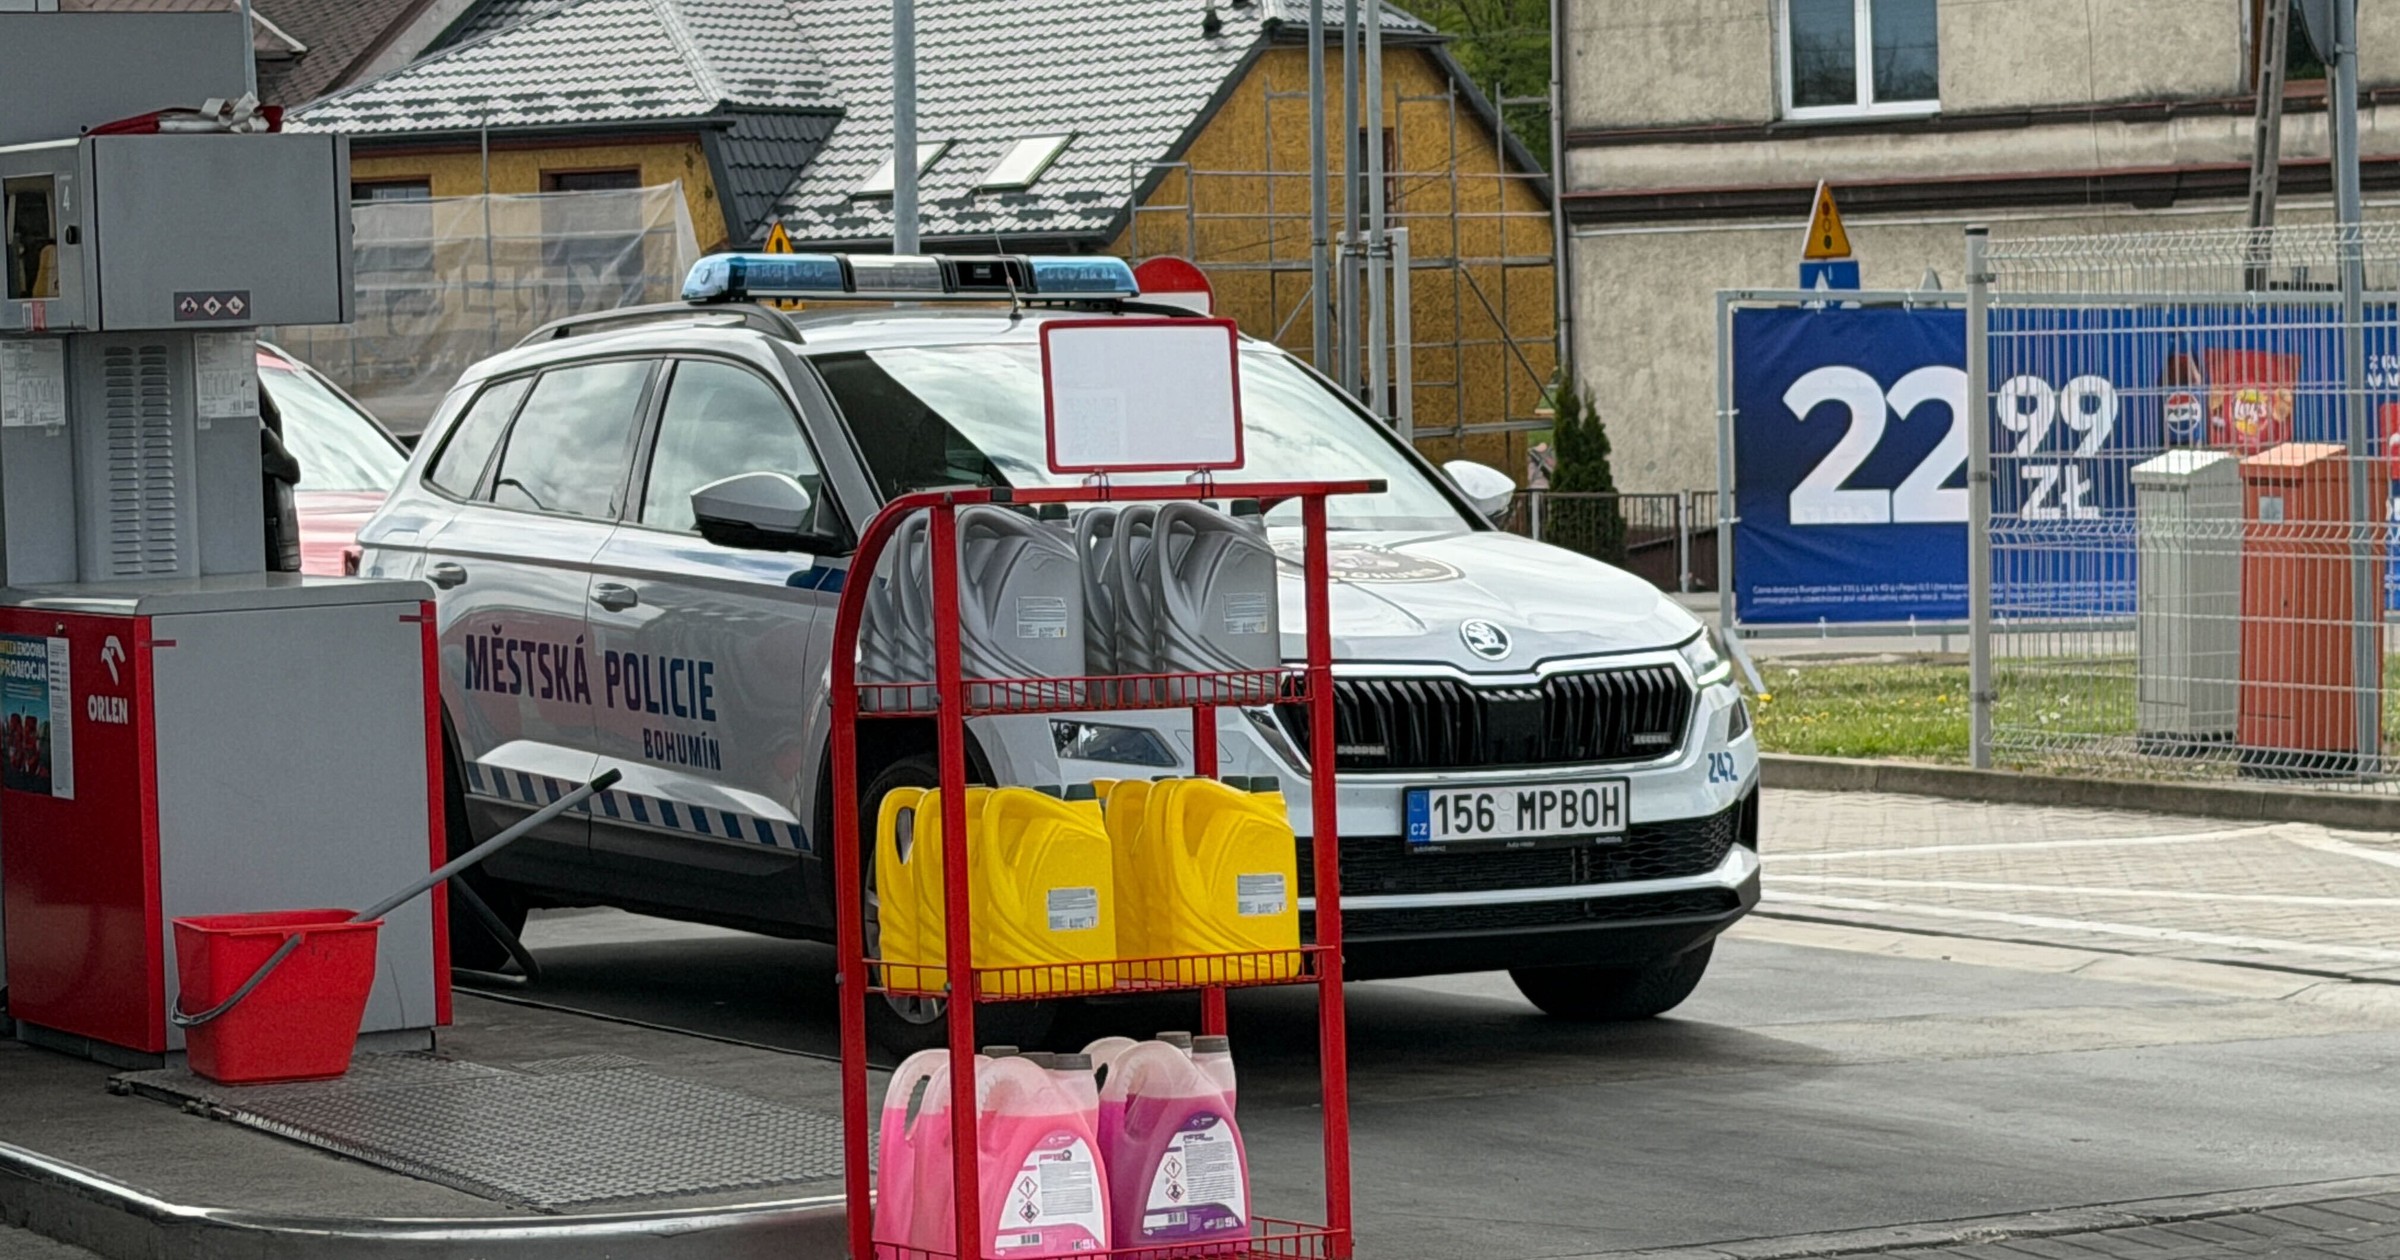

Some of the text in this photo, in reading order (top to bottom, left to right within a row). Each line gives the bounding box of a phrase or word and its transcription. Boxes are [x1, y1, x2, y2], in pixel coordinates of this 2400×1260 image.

[62, 185, 71, 211] 4
[1782, 366, 2119, 524] 22 99
[2021, 464, 2101, 521] ZŁ
[465, 624, 717, 722] MĚSTSKÁ POLICIE
[87, 694, 129, 725] ORLEN
[643, 728, 722, 771] BOHUMÍN
[1707, 751, 1738, 783] 242
[1410, 822, 1428, 836] CZ
[1434, 786, 1619, 835] 156 MPBOH
